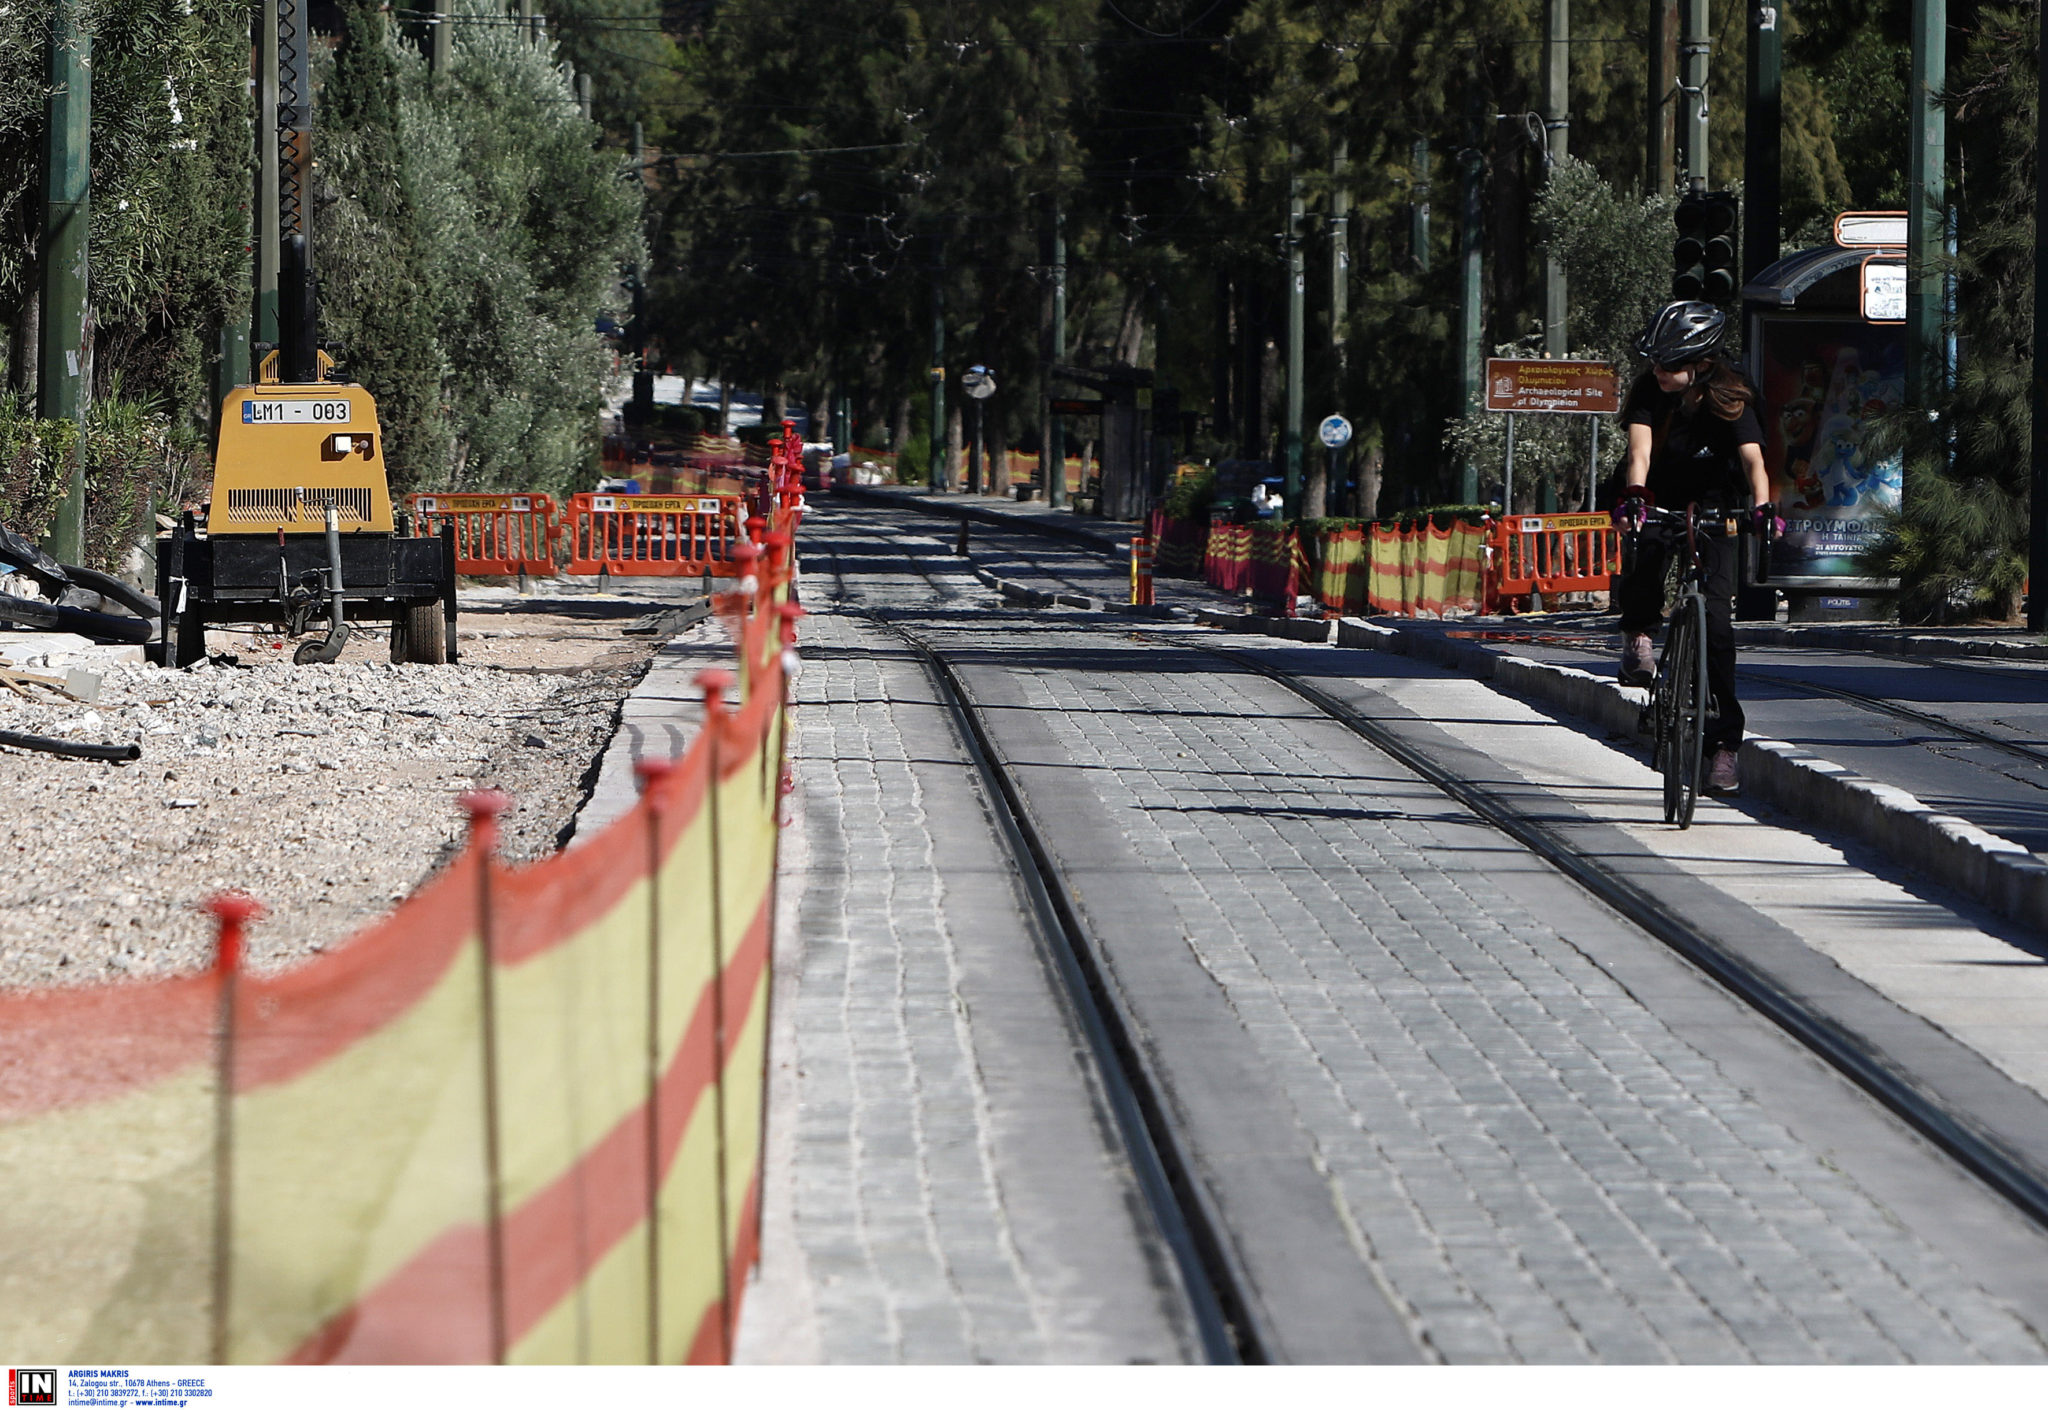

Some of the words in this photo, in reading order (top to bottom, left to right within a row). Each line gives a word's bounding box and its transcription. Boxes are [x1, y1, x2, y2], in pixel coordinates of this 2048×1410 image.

[1518, 387, 1582, 398] Archaeological
[1585, 388, 1603, 397] Site
[1517, 398, 1526, 406] of
[313, 403, 346, 420] 003
